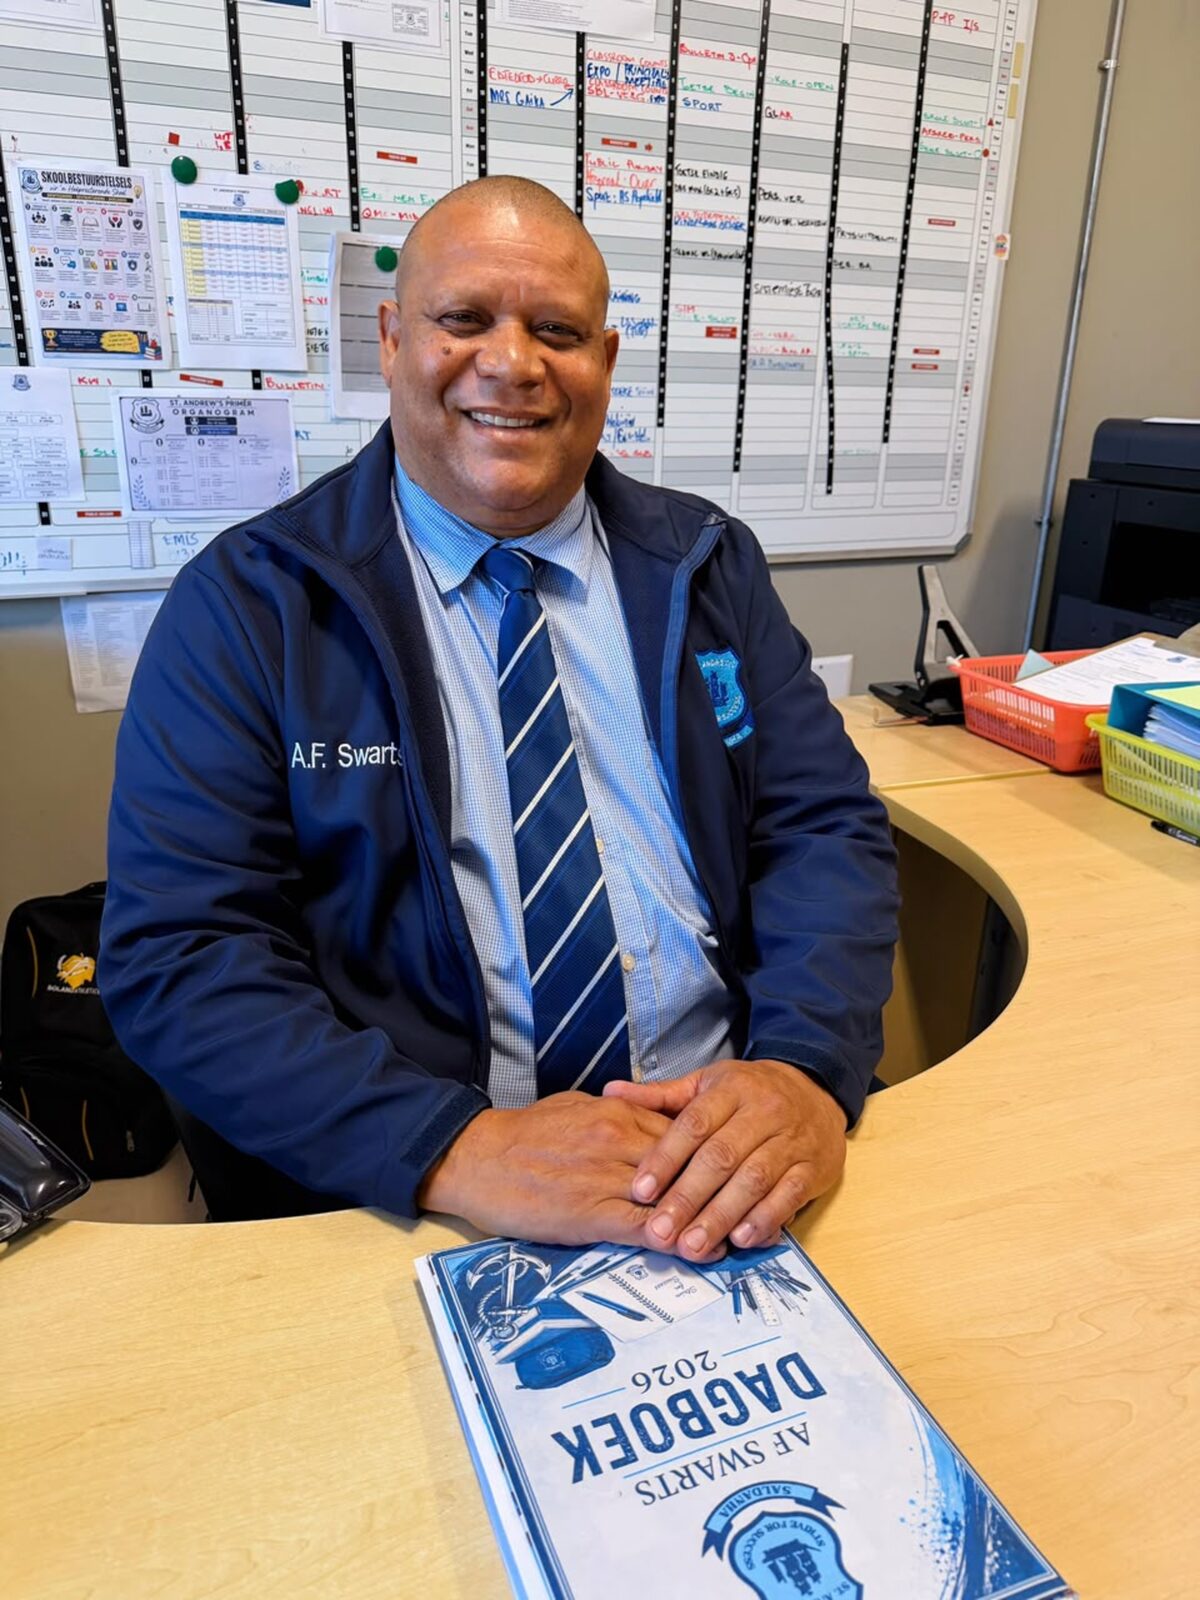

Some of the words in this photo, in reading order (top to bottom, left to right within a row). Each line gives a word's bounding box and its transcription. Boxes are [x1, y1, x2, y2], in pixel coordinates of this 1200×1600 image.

[680, 42, 724, 60] BULLETIN
[587, 62, 611, 79] EXPO
[490, 87, 510, 105] MRS
[682, 97, 722, 112] SPORT
[40, 170, 133, 189] SKOOLBESTUURSTELSELS
[265, 377, 325, 391] BULLETIN
[172, 408, 255, 416] ORGANOGRAM
[291, 742, 326, 768] A.F.
[631, 1349, 719, 1395] 2026
[551, 1351, 828, 1485] DAGBOEK
[773, 1422, 811, 1457] AF
[634, 1440, 767, 1507] SWARTS
[719, 1484, 793, 1518] SALDANHA
[764, 1520, 788, 1533] FOR
[790, 1519, 827, 1548] STRIVE
[742, 1528, 766, 1571] SUCCESS
